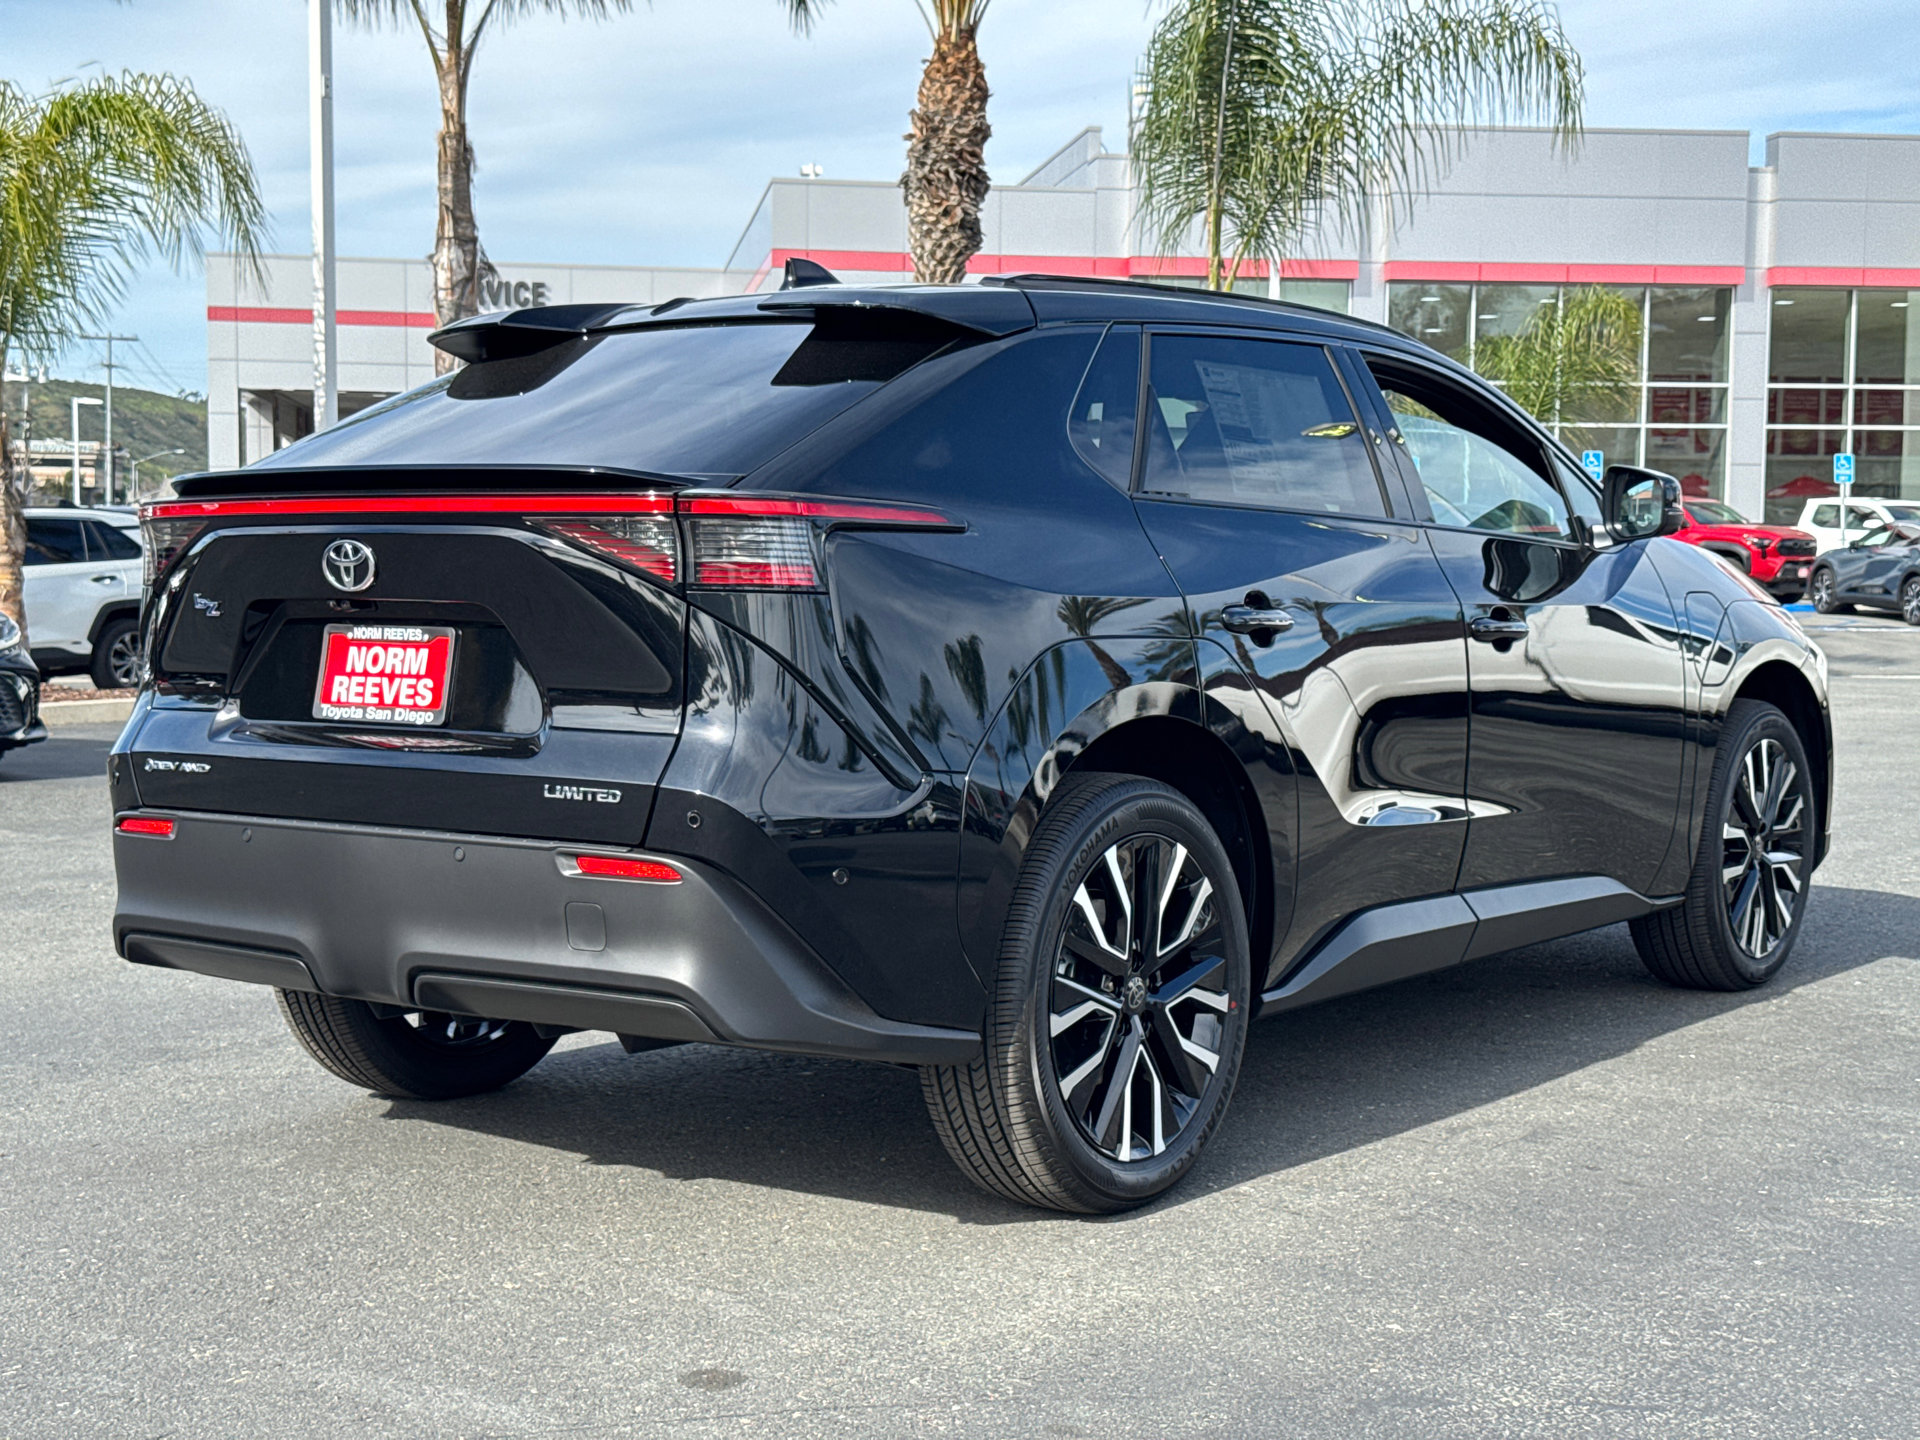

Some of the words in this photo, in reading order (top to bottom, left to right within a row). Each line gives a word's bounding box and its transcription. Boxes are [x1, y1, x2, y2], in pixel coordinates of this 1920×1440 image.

[353, 626, 382, 640] NORM
[383, 627, 423, 641] REEVES
[345, 645, 429, 676] NORM
[330, 675, 434, 707] REEVES
[320, 703, 364, 720] Toyota
[365, 706, 392, 721] San
[394, 708, 434, 725] Diego
[543, 783, 622, 804] LIMITED
[1061, 815, 1120, 891] YOKOHAMA
